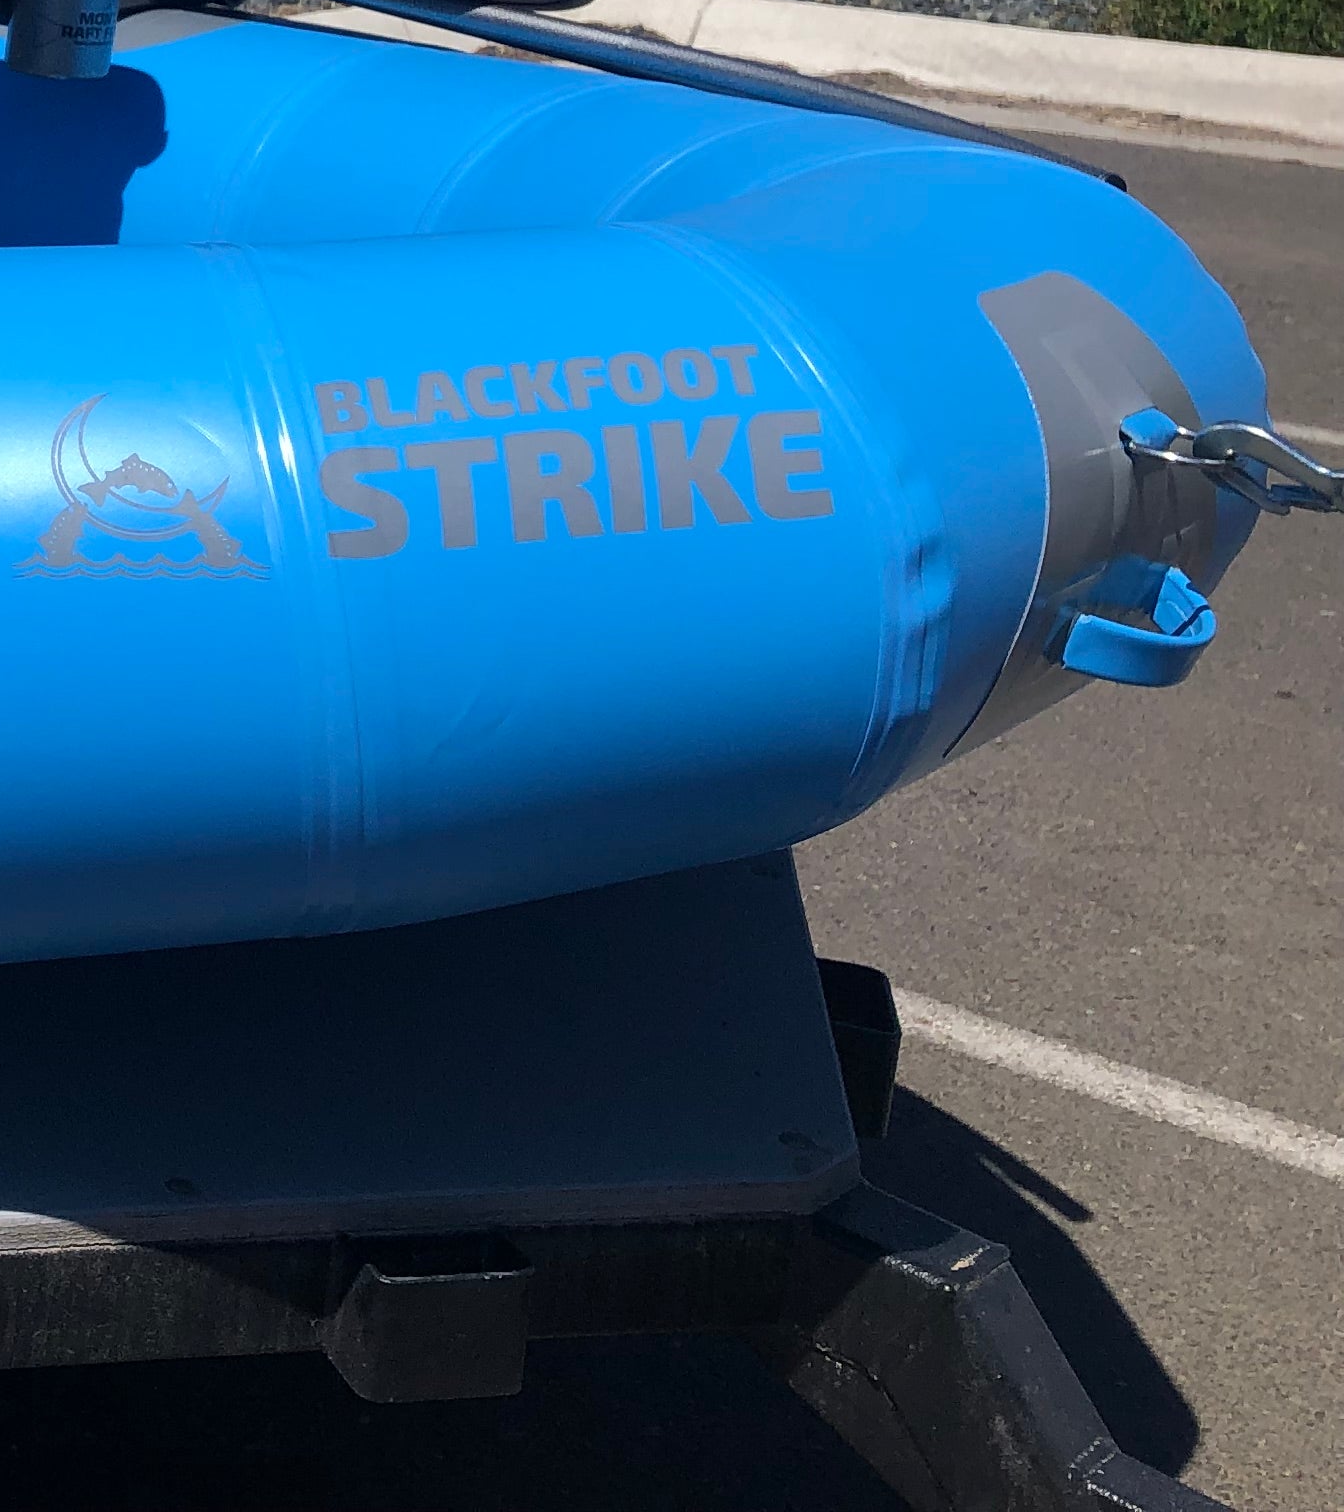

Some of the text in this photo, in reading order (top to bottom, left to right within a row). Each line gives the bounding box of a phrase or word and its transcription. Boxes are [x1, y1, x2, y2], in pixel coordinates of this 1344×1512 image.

[61, 25, 102, 39] RAFT
[315, 344, 759, 435] BLACKFOOT
[319, 410, 835, 560] STRIKE
